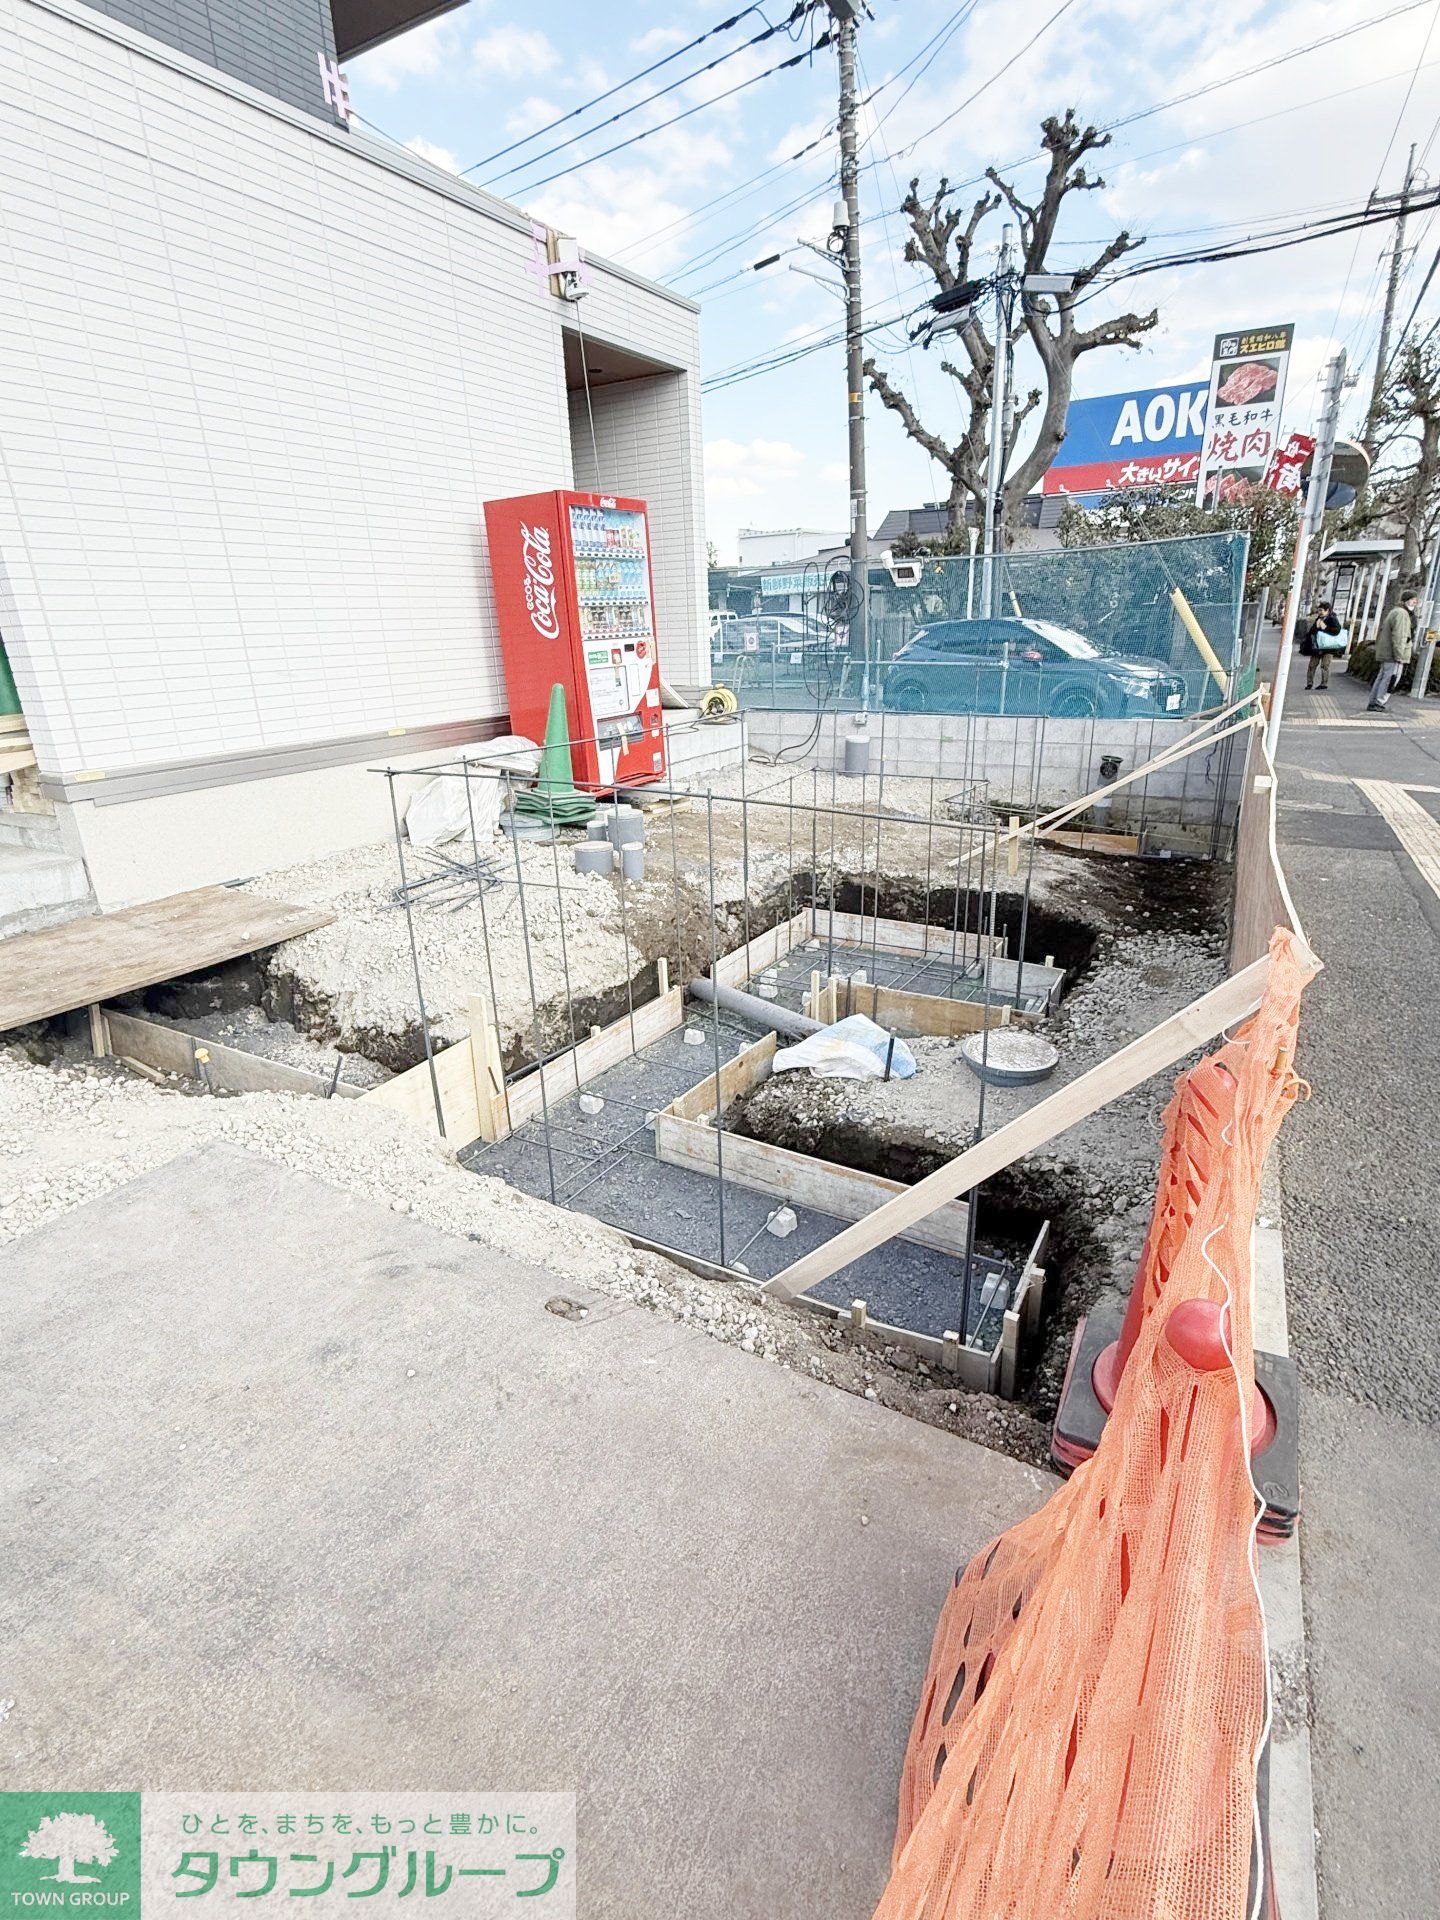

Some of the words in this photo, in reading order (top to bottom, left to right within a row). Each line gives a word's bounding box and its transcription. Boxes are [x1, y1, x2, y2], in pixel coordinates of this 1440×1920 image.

[1212, 408, 1274, 429] 黒毛和牛
[1207, 428, 1272, 463] 焼肉
[520, 521, 560, 640] Coca-Cola
